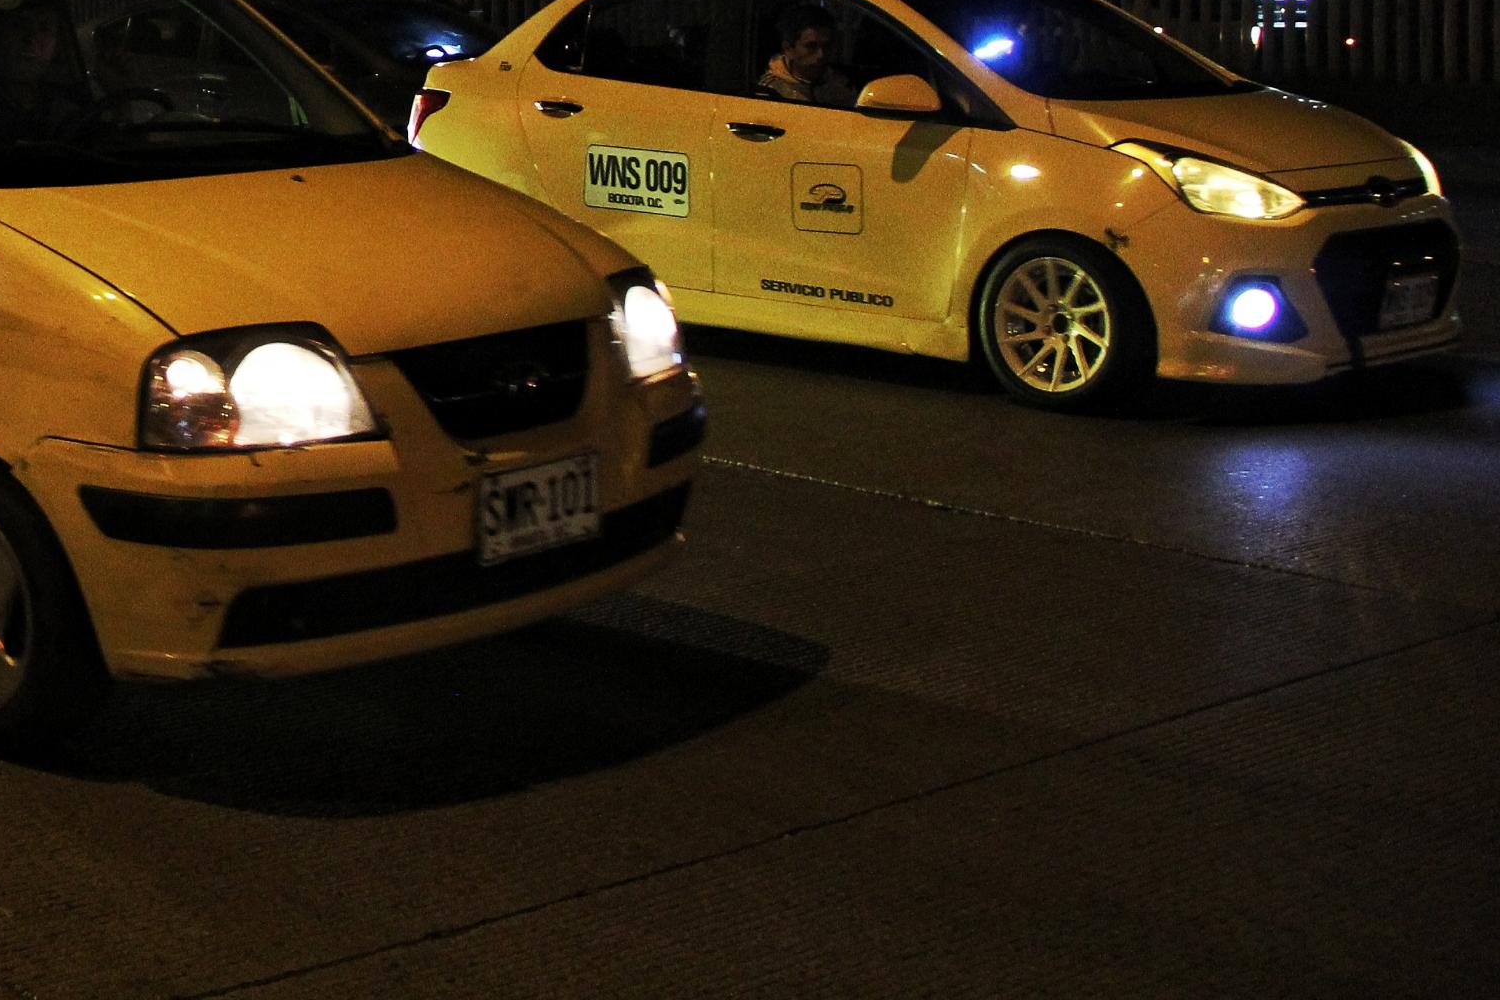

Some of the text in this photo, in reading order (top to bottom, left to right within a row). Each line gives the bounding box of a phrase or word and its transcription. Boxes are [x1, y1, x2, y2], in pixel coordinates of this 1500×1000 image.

[588, 152, 687, 195] WNS 009
[607, 192, 646, 207] BOGOTA
[760, 278, 894, 308] SERVICIO PUBLICO
